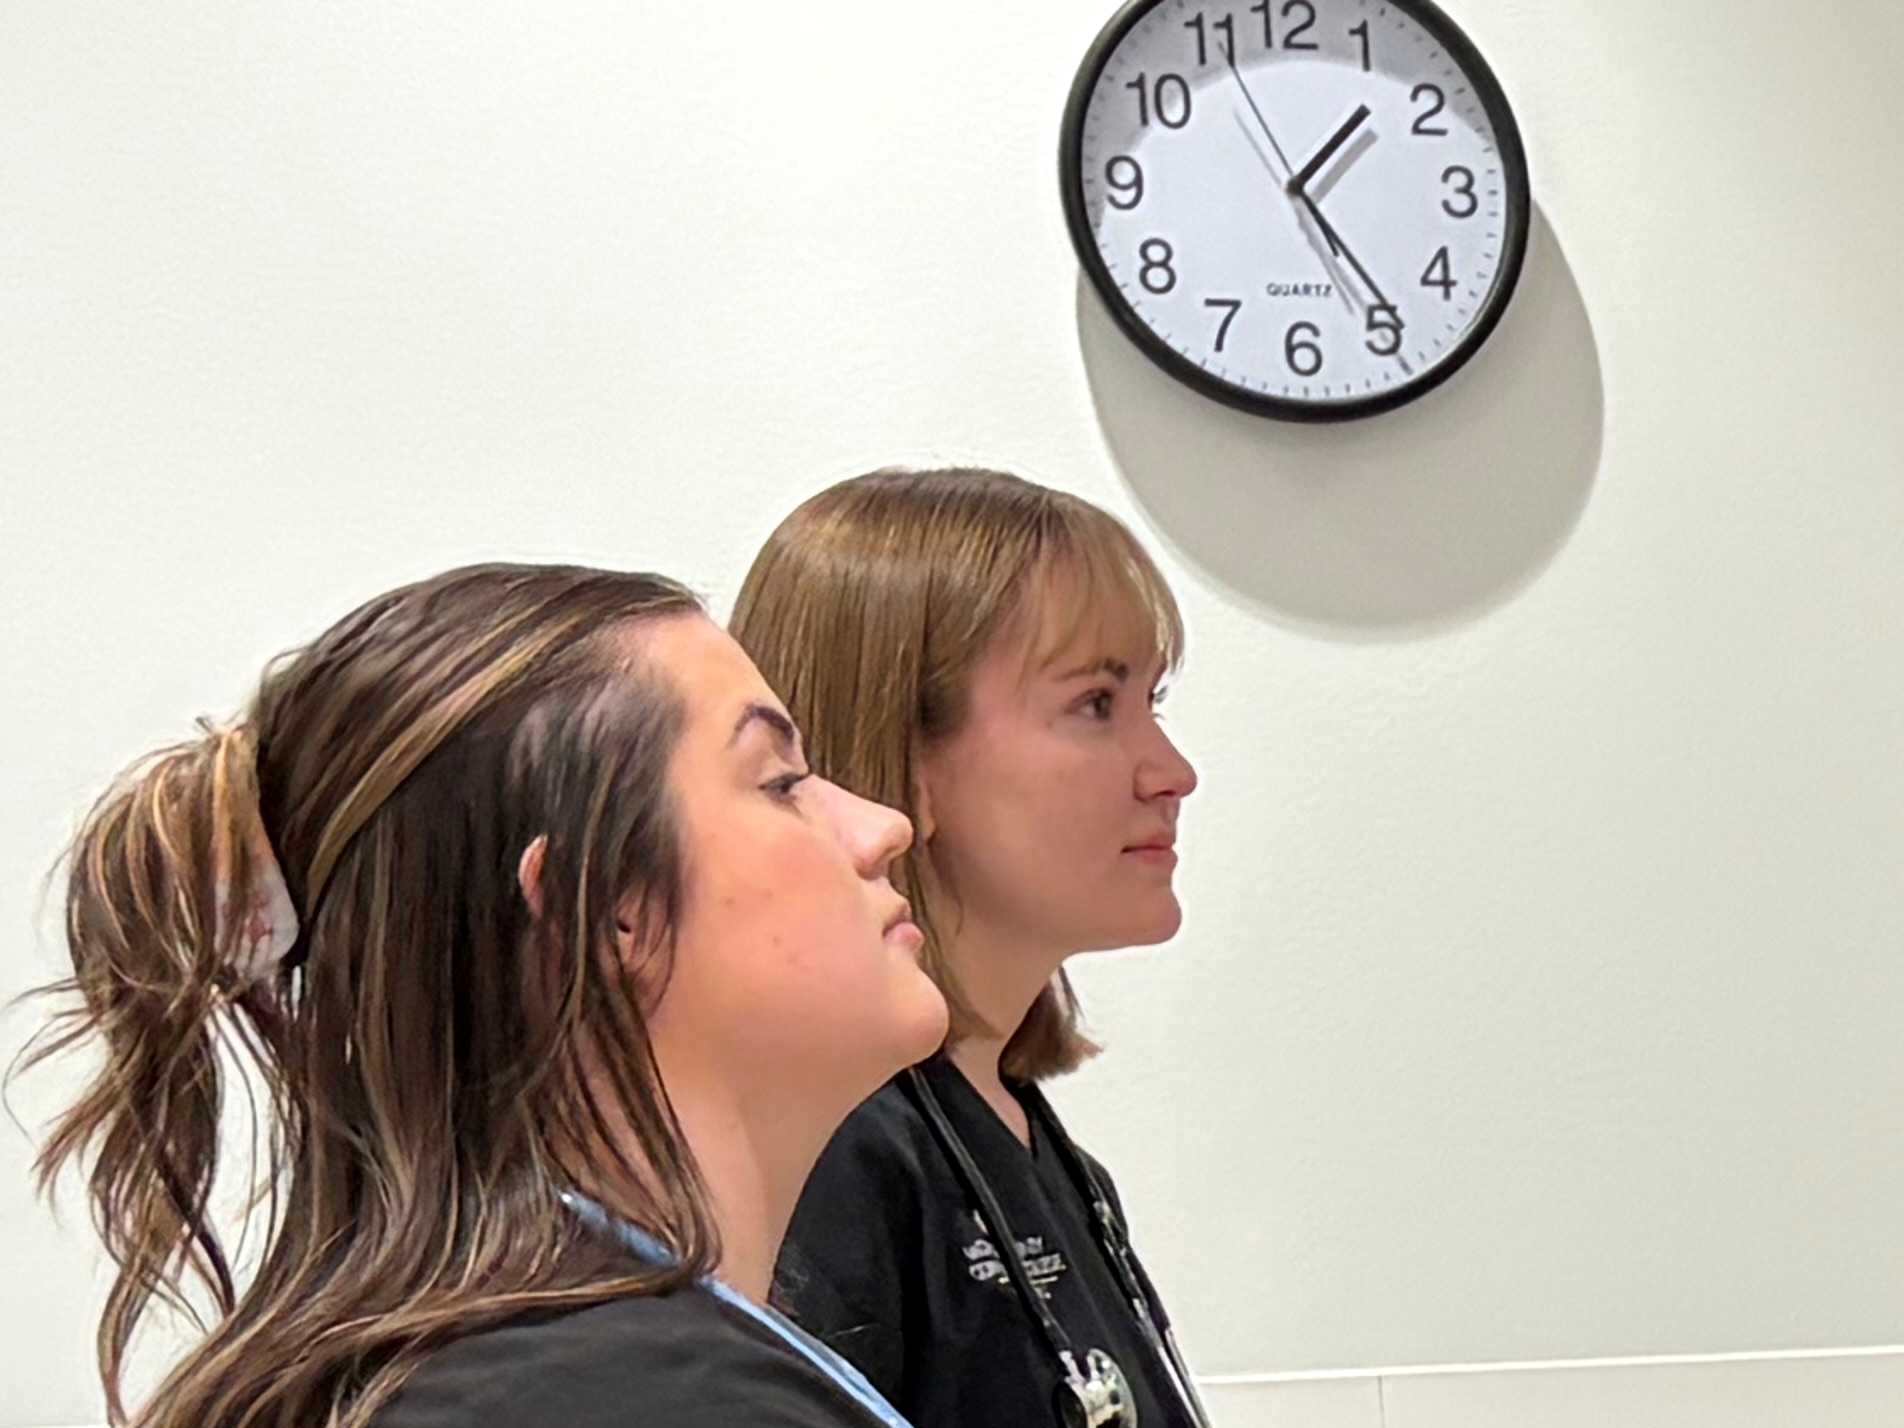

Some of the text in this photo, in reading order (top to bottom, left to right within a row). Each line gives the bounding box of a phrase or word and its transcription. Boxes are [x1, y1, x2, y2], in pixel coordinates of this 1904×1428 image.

[1184, 12, 1236, 67] 11
[1251, 0, 1319, 51] 12
[1349, 21, 1373, 72] 1
[1126, 72, 1193, 129] 10
[1409, 83, 1449, 136] 2
[1105, 155, 1144, 210] 9
[1441, 165, 1479, 219] 3
[1139, 237, 1177, 294] 8
[1266, 283, 1333, 298] QUARTZ
[1419, 247, 1457, 300] 4
[1205, 299, 1242, 352] 7
[1284, 322, 1323, 376] 6
[1365, 304, 1403, 356] 5
